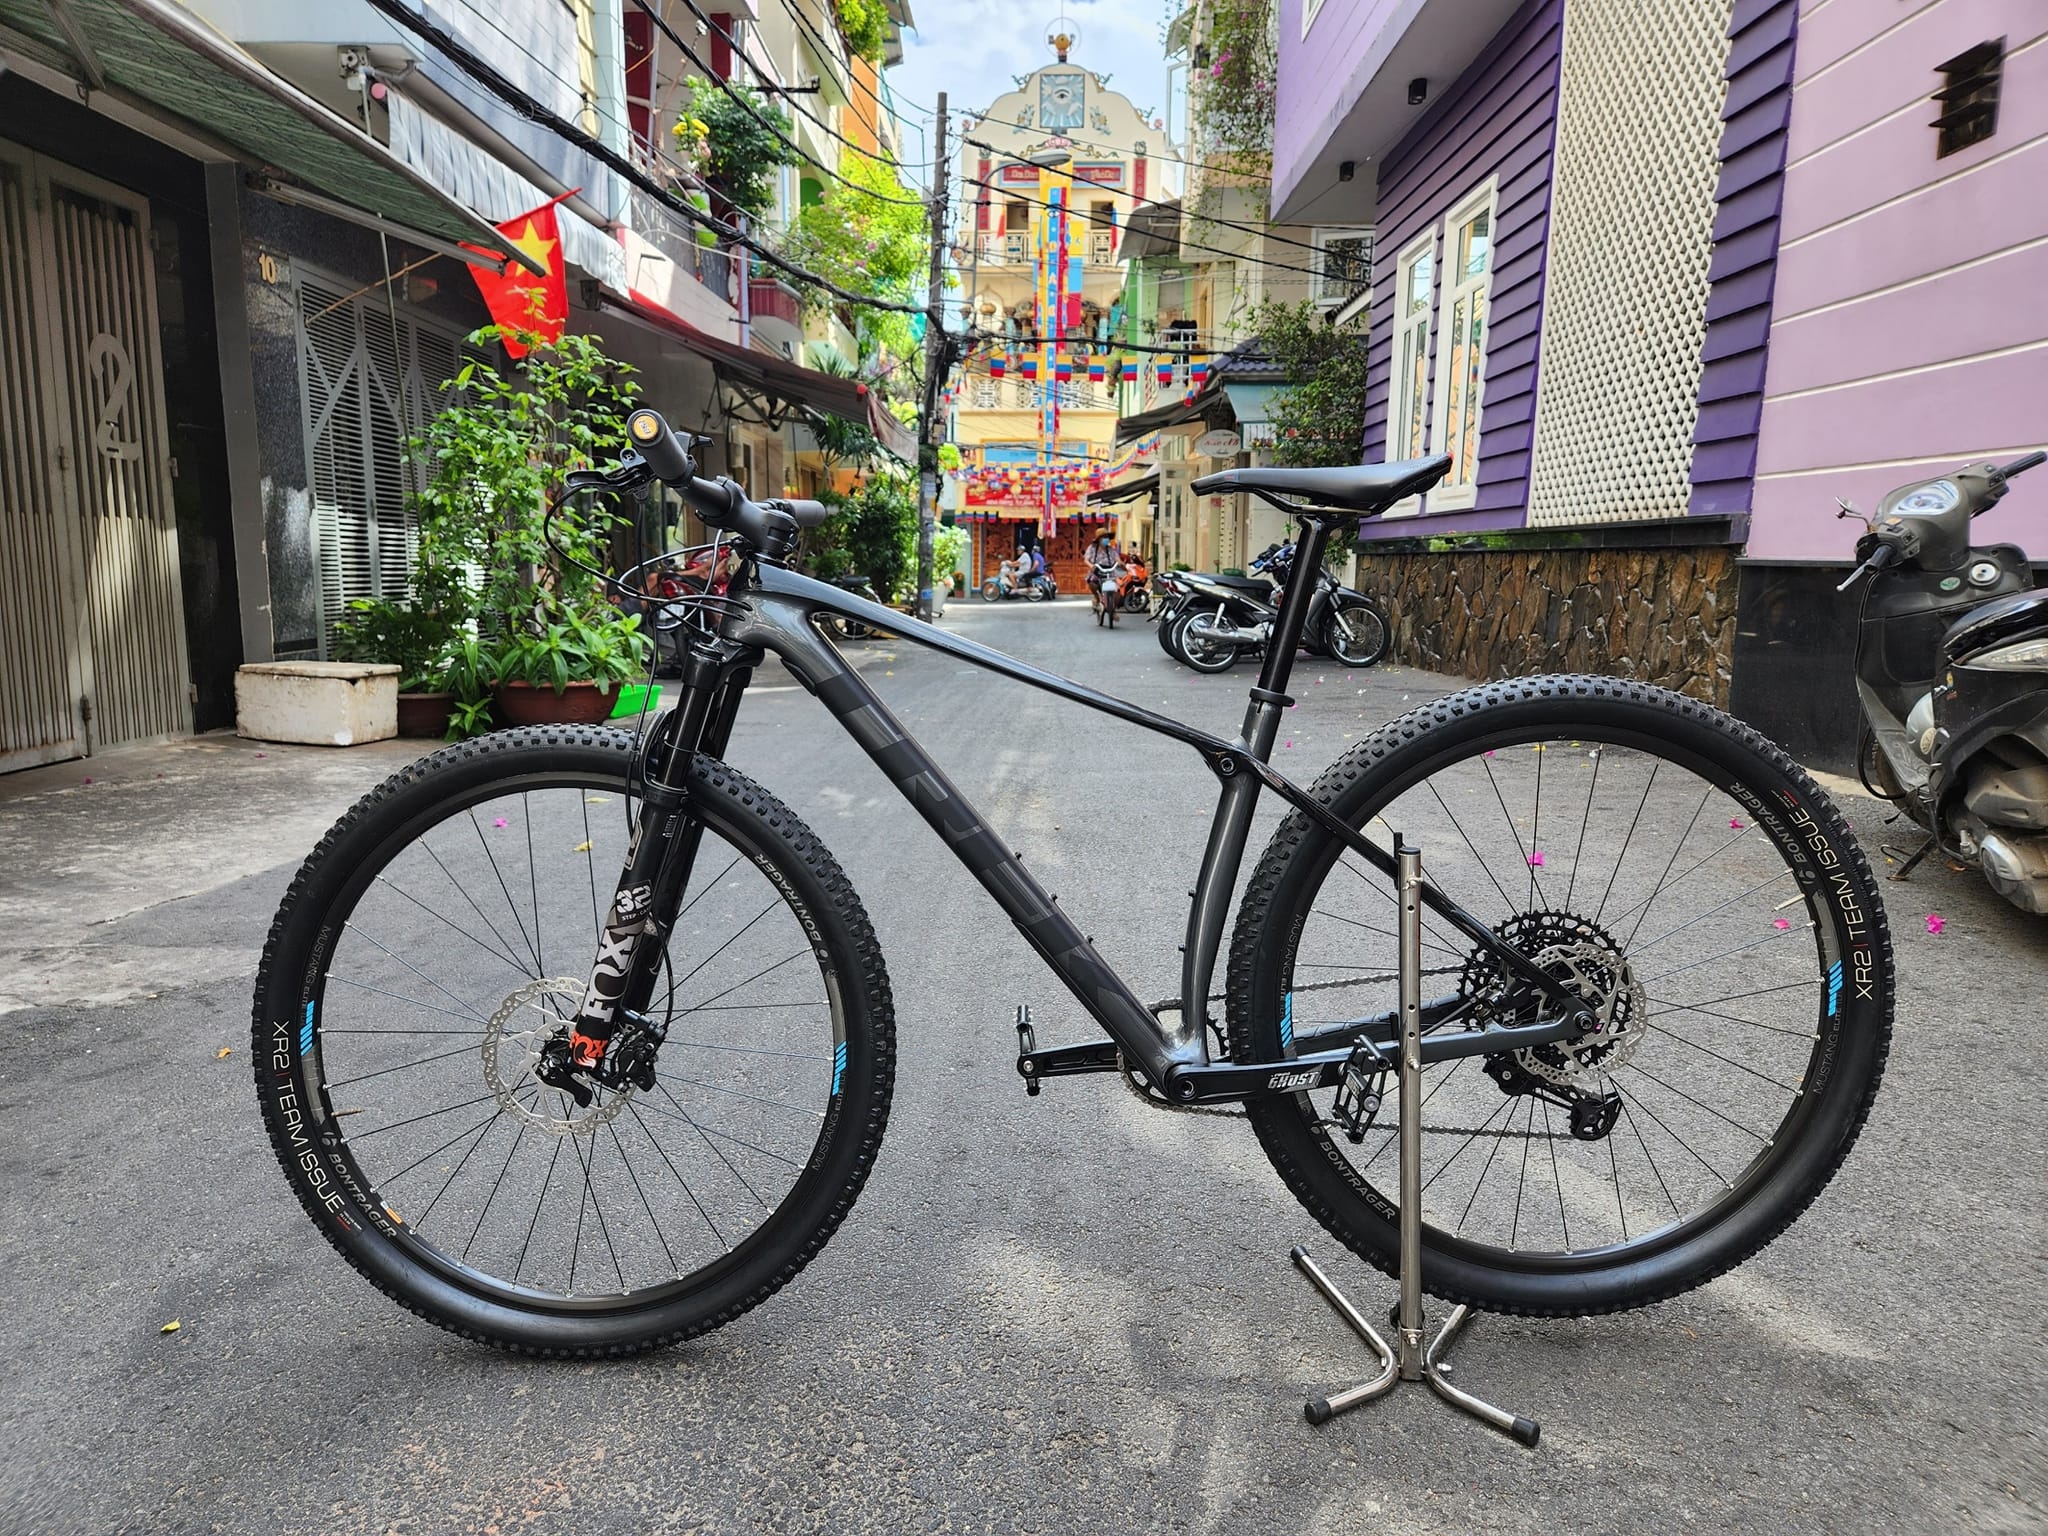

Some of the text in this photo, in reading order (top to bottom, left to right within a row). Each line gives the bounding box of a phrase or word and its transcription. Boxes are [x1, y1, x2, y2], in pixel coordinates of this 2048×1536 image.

[258, 252, 277, 285] 10
[1728, 782, 1806, 866] BONTRAGER
[615, 885, 652, 914] 32
[754, 852, 824, 943] BONTRAGER
[1787, 807, 1873, 1002] XR2 TEAM ISSUE
[304, 924, 332, 984] MUSTANG
[581, 929, 636, 1024] FOX
[1281, 912, 1304, 976] MUSTANG
[569, 1030, 608, 1069] FOX
[1811, 1033, 1839, 1095] MUSTANG
[271, 1020, 346, 1215] XR2 TEAM ISSUE
[810, 1112, 839, 1172] MUSTANG
[327, 1152, 397, 1239] BONTRAGER
[1319, 1139, 1396, 1220] BONTRAGER
